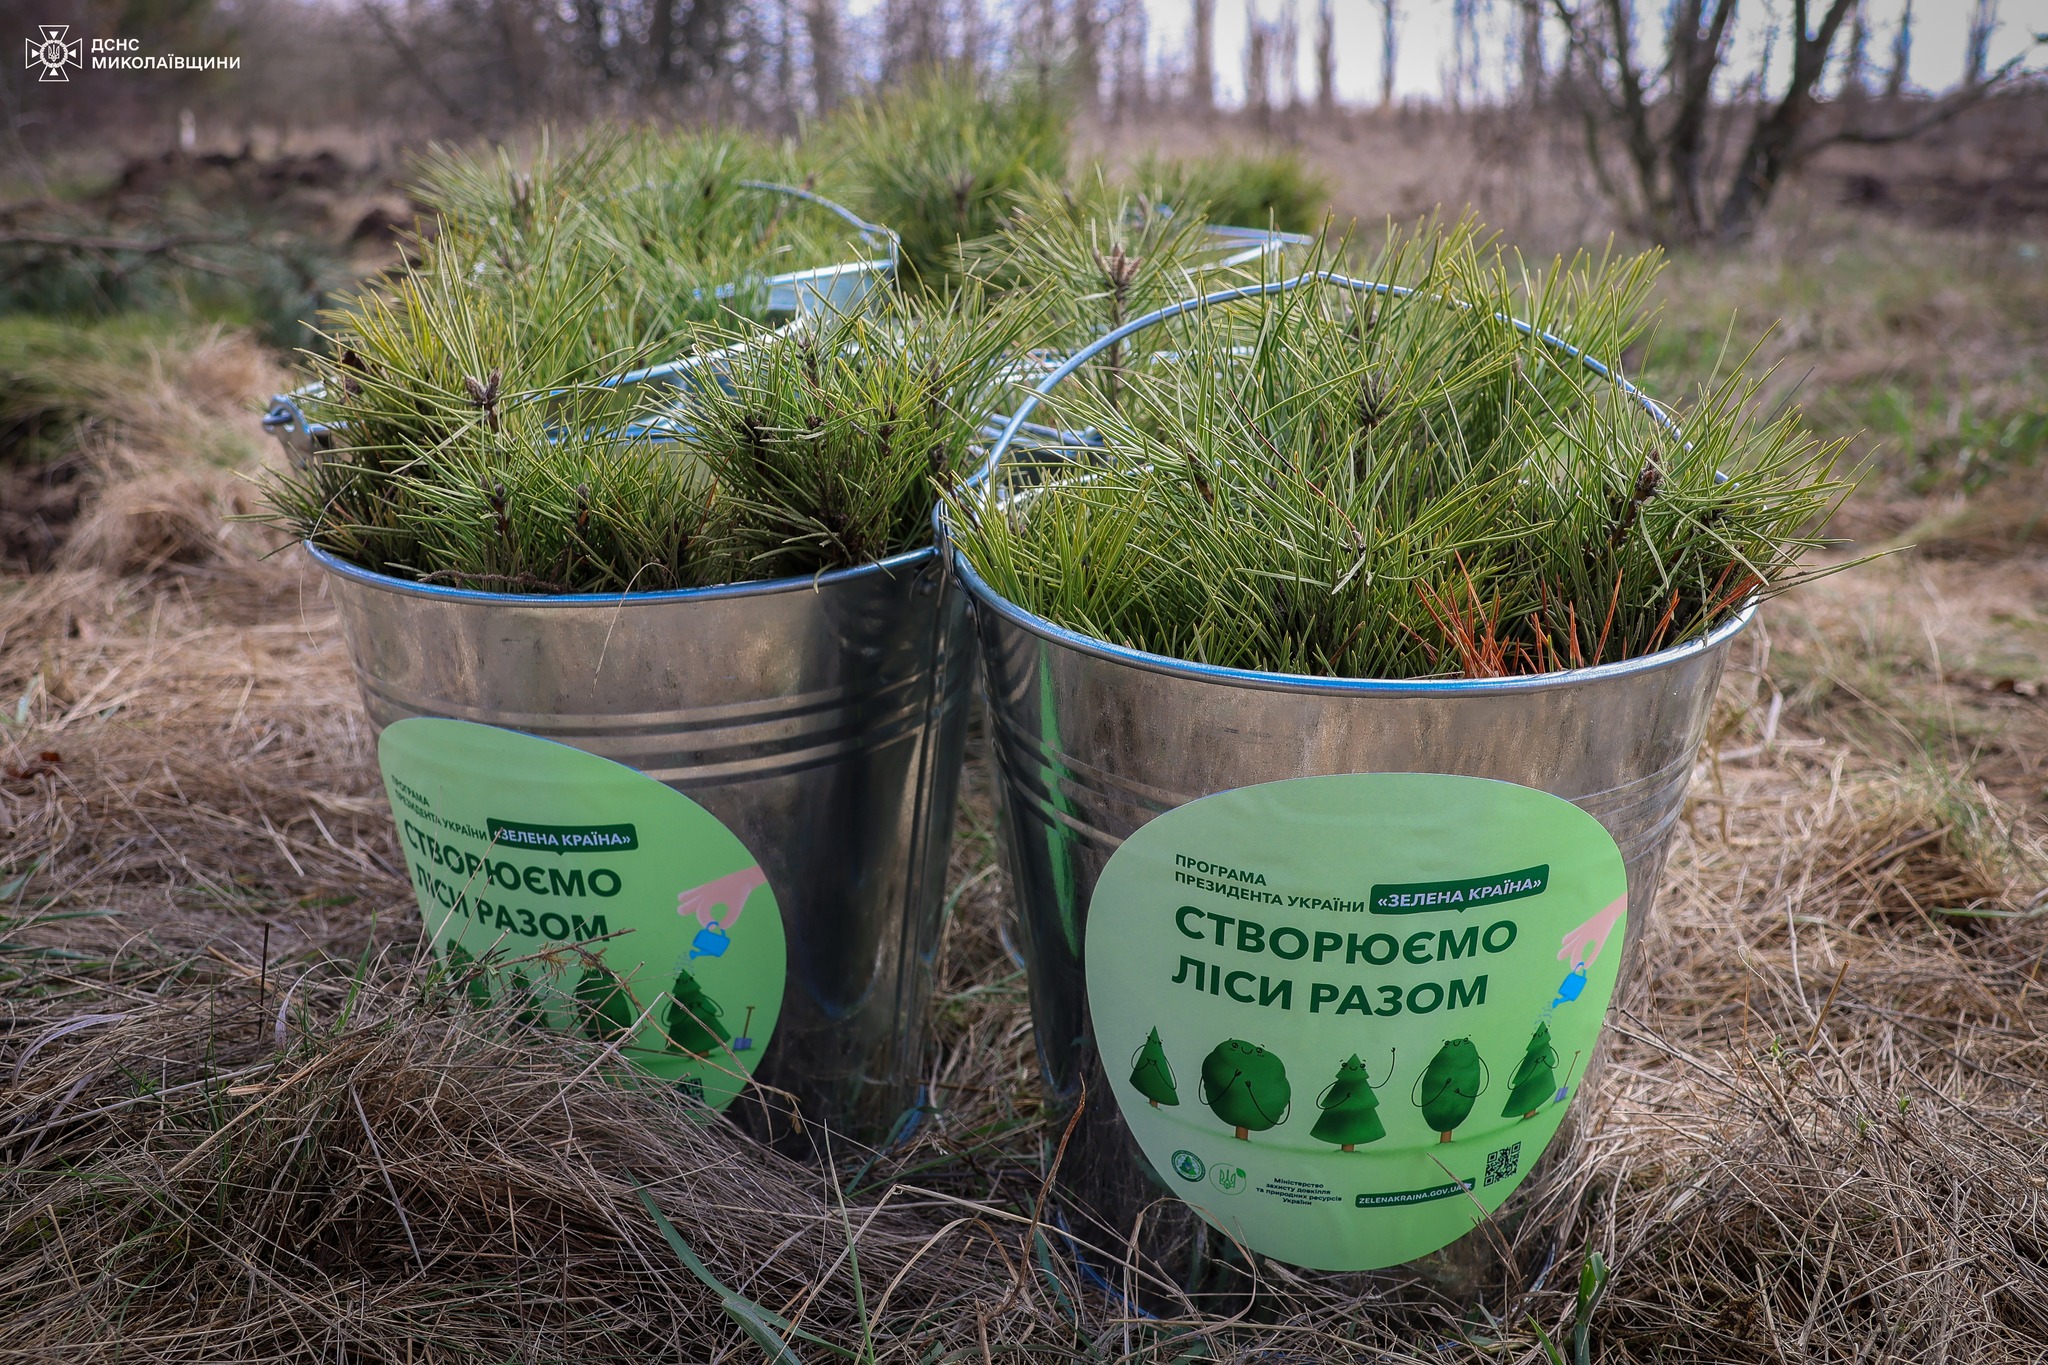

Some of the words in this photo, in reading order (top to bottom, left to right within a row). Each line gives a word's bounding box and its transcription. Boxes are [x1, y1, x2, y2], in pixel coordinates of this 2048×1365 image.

[442, 818, 488, 841] УКРАЇНИ
[494, 829, 559, 846] «ЗЕЛЕНА
[561, 831, 631, 847] КРАЇНА»
[404, 819, 622, 898] СТВОРЮЄМО
[1175, 854, 1267, 886] ПРОГРАМА
[416, 862, 470, 919] ЛІСИ
[475, 897, 611, 943] РАЗОМ
[1175, 871, 1284, 906] ПРЕЗИДЕНТА
[1287, 895, 1365, 913] УКРАЇНИ
[1377, 890, 1464, 907] «ЗЕЛЕНА
[1468, 878, 1542, 901] КРАЇНА»
[1175, 905, 1518, 966] СТВОРЮЄМО
[1171, 955, 1293, 1011] ЛІСИ
[1309, 974, 1489, 1017] РАЗОМ
[1266, 1183, 1296, 1192] захисту
[1296, 1187, 1331, 1195] довкілля
[1266, 1189, 1308, 1199] природних
[1273, 1177, 1324, 1189] Міністерство
[1358, 1184, 1462, 1205] ZELENAKRAINA.GOV.UA
[1282, 1197, 1312, 1206] України
